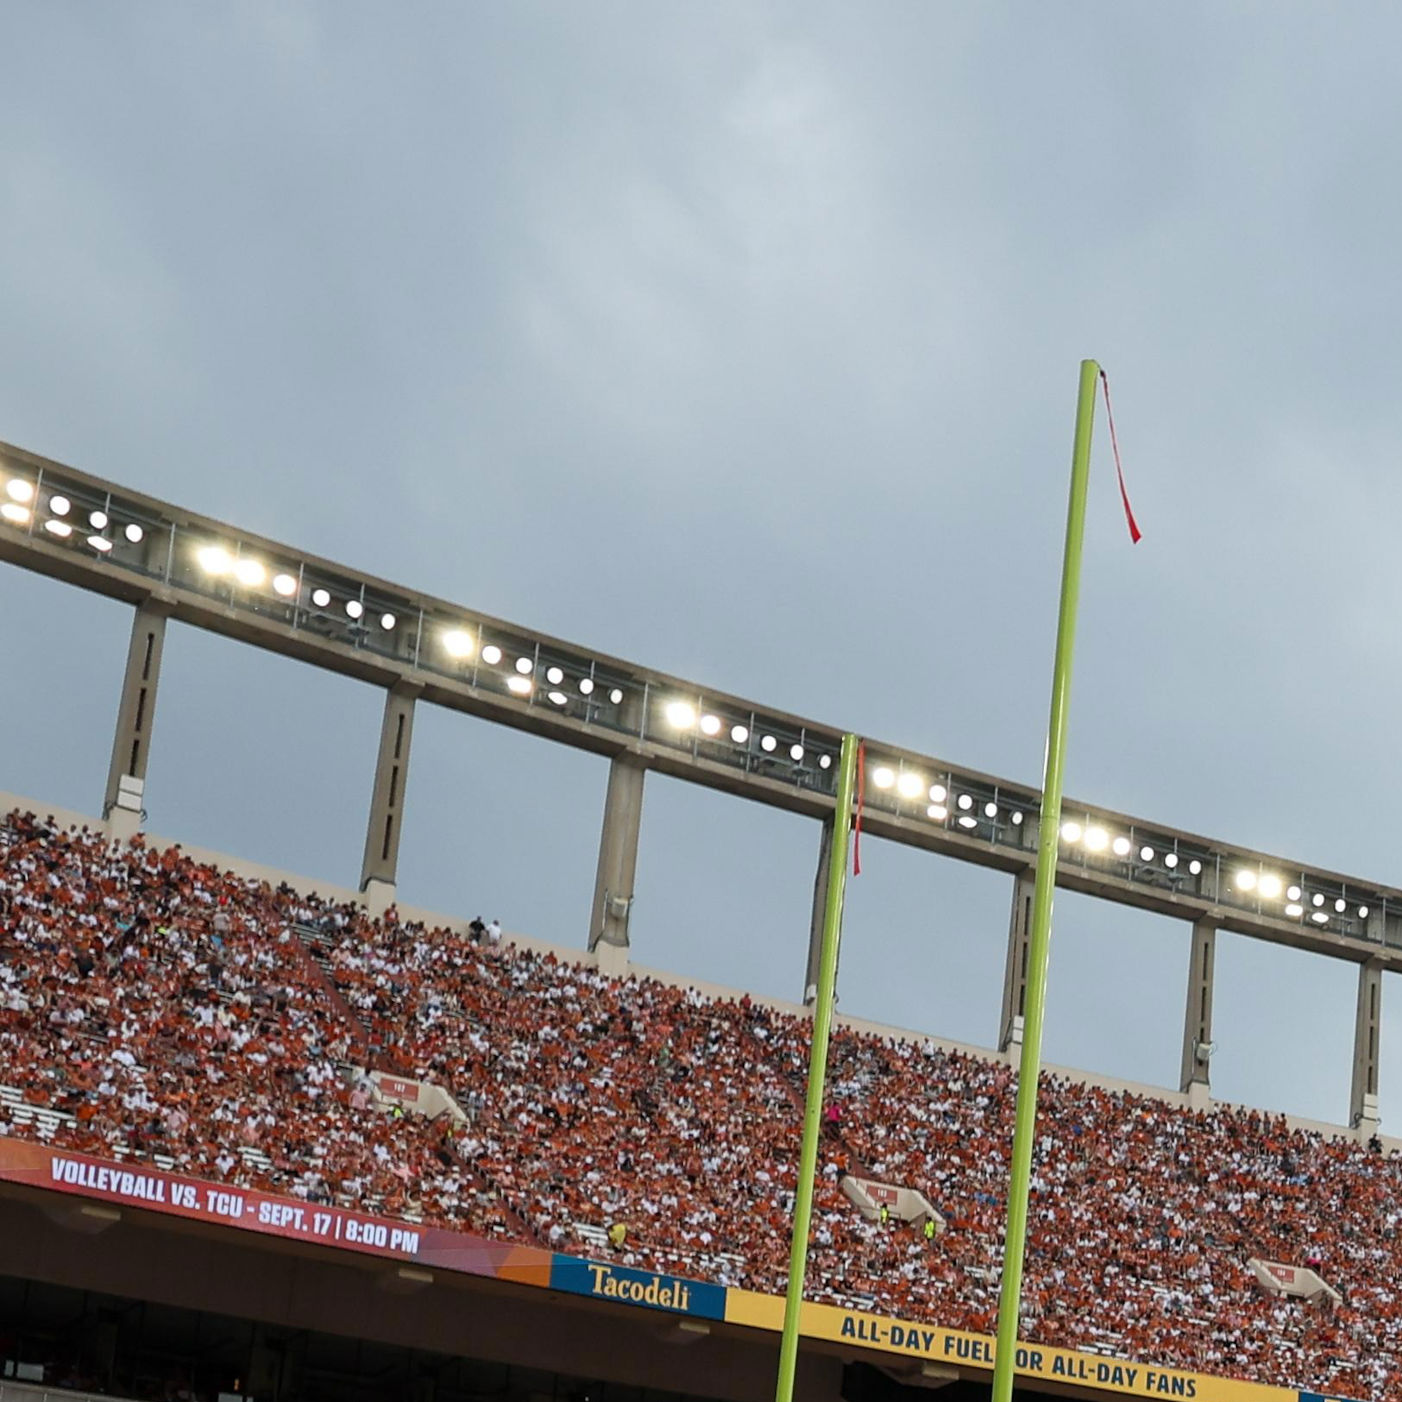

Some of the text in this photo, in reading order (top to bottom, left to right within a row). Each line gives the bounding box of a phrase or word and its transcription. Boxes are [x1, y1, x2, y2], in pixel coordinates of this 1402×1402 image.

[52, 1157, 165, 1202] VOLLEYBALL
[171, 1184, 200, 1210] VS.
[207, 1190, 243, 1218] TCU
[258, 1201, 308, 1232] SEPT.
[313, 1212, 331, 1236] 17
[345, 1219, 387, 1248] 8:00
[390, 1230, 420, 1254] PM
[588, 1264, 689, 1311] Tacodeli
[841, 1316, 1197, 1398] ALL-DAY FUEL OR ALL-DAY FANS
